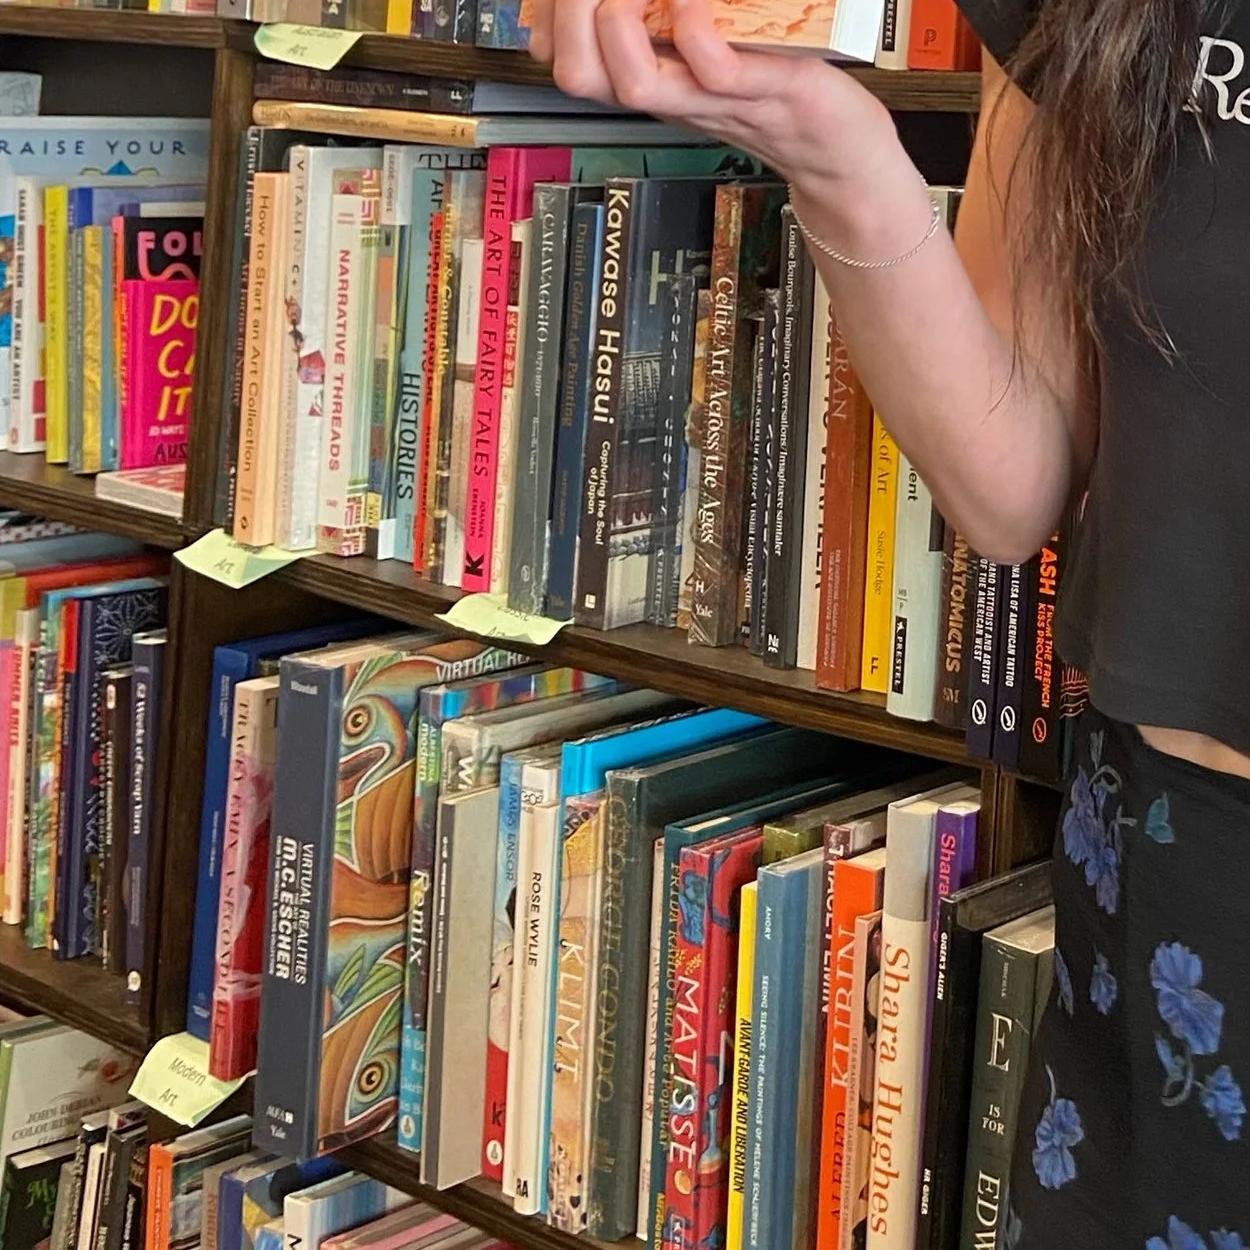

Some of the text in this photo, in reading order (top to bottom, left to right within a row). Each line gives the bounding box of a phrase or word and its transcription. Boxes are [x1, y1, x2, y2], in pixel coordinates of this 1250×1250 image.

[105, 140, 186, 156] YOUR
[255, 241, 267, 260] to
[257, 194, 271, 239] How
[252, 265, 267, 313] Start
[537, 212, 555, 345] CARAVAGGIO
[592, 189, 630, 425] Kawase Hasui
[249, 343, 263, 378] Art
[251, 317, 262, 342] an
[327, 249, 350, 471] NARRATIVE THREADS
[473, 174, 508, 477] THE ART OF FAIRY TALES
[157, 386, 193, 421] IT
[241, 379, 261, 474] Collection
[396, 373, 421, 501] HISTORIES
[698, 275, 735, 544] Celtic Art Across the Ages
[586, 465, 600, 515] of Japan
[594, 440, 611, 545] Capturing the Soul
[877, 442, 891, 493] of Art
[973, 558, 988, 662] OF THE AMERICAN WEST
[1034, 601, 1047, 682] KISS PROJECT
[436, 654, 500, 684] VIRTUAL
[893, 635, 904, 687] PRESTEL
[419, 722, 430, 781] modern
[937, 832, 958, 895] Shara
[294, 842, 315, 985] VIRTUAL REALITIES
[408, 870, 430, 967] Remix
[527, 871, 543, 968] ROSE WYLIE
[559, 938, 585, 1083] KLIMT
[986, 1012, 1012, 1073] E
[158, 1087, 179, 1107] Art
[167, 1056, 207, 1087] Modern
[667, 974, 701, 1165] MATISSE
[733, 1017, 752, 1194] AVANT-GARDE AND LIBERATION
[870, 943, 911, 1236] Shara Hughes
[988, 1104, 1001, 1118] IS
